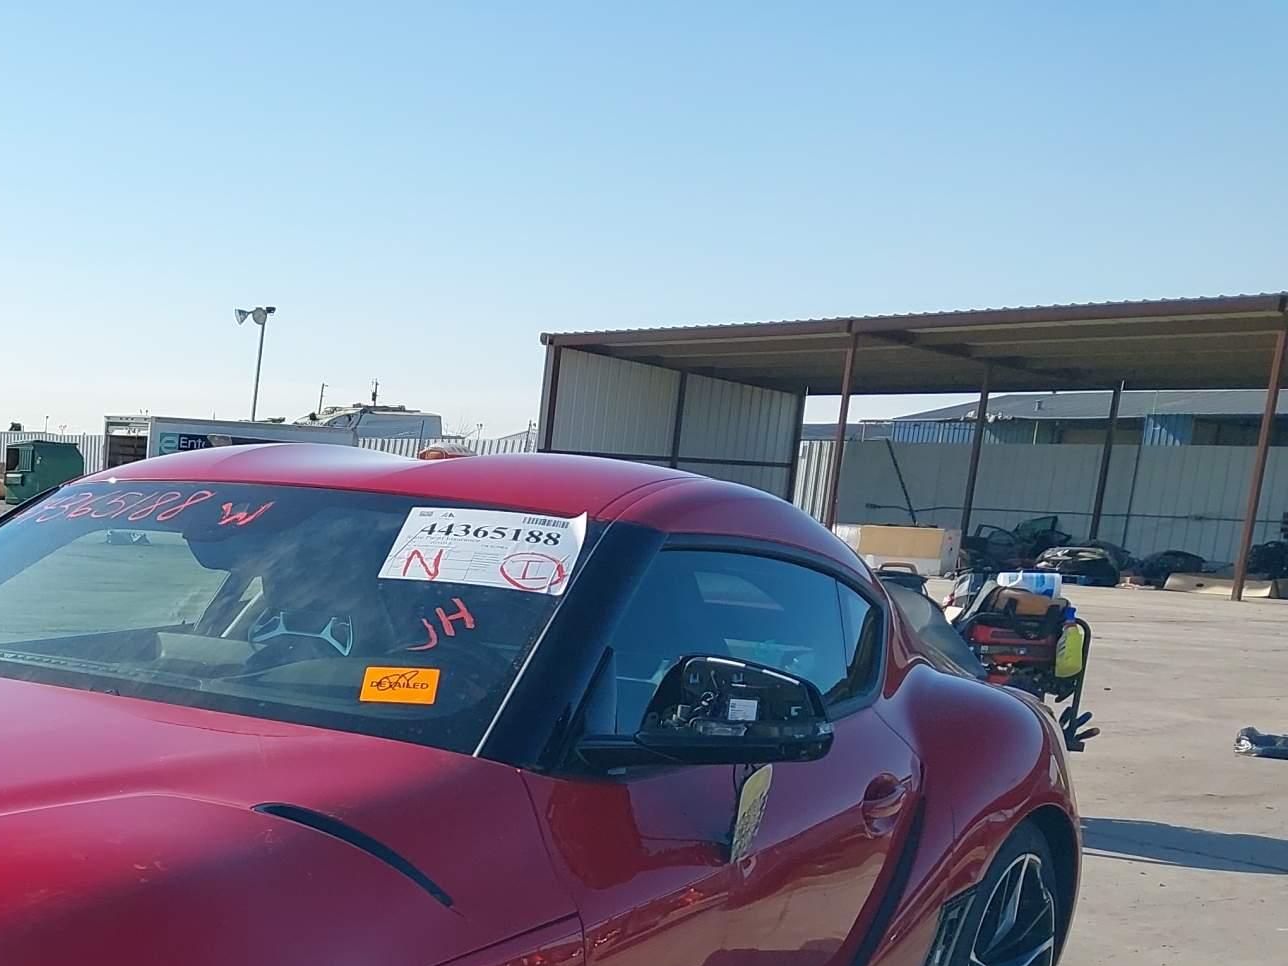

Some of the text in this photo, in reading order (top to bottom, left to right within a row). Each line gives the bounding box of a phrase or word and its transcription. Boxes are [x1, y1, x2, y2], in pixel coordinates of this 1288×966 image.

[420, 522, 562, 547] 44365188
[401, 548, 444, 580] N
[405, 597, 476, 651] JH
